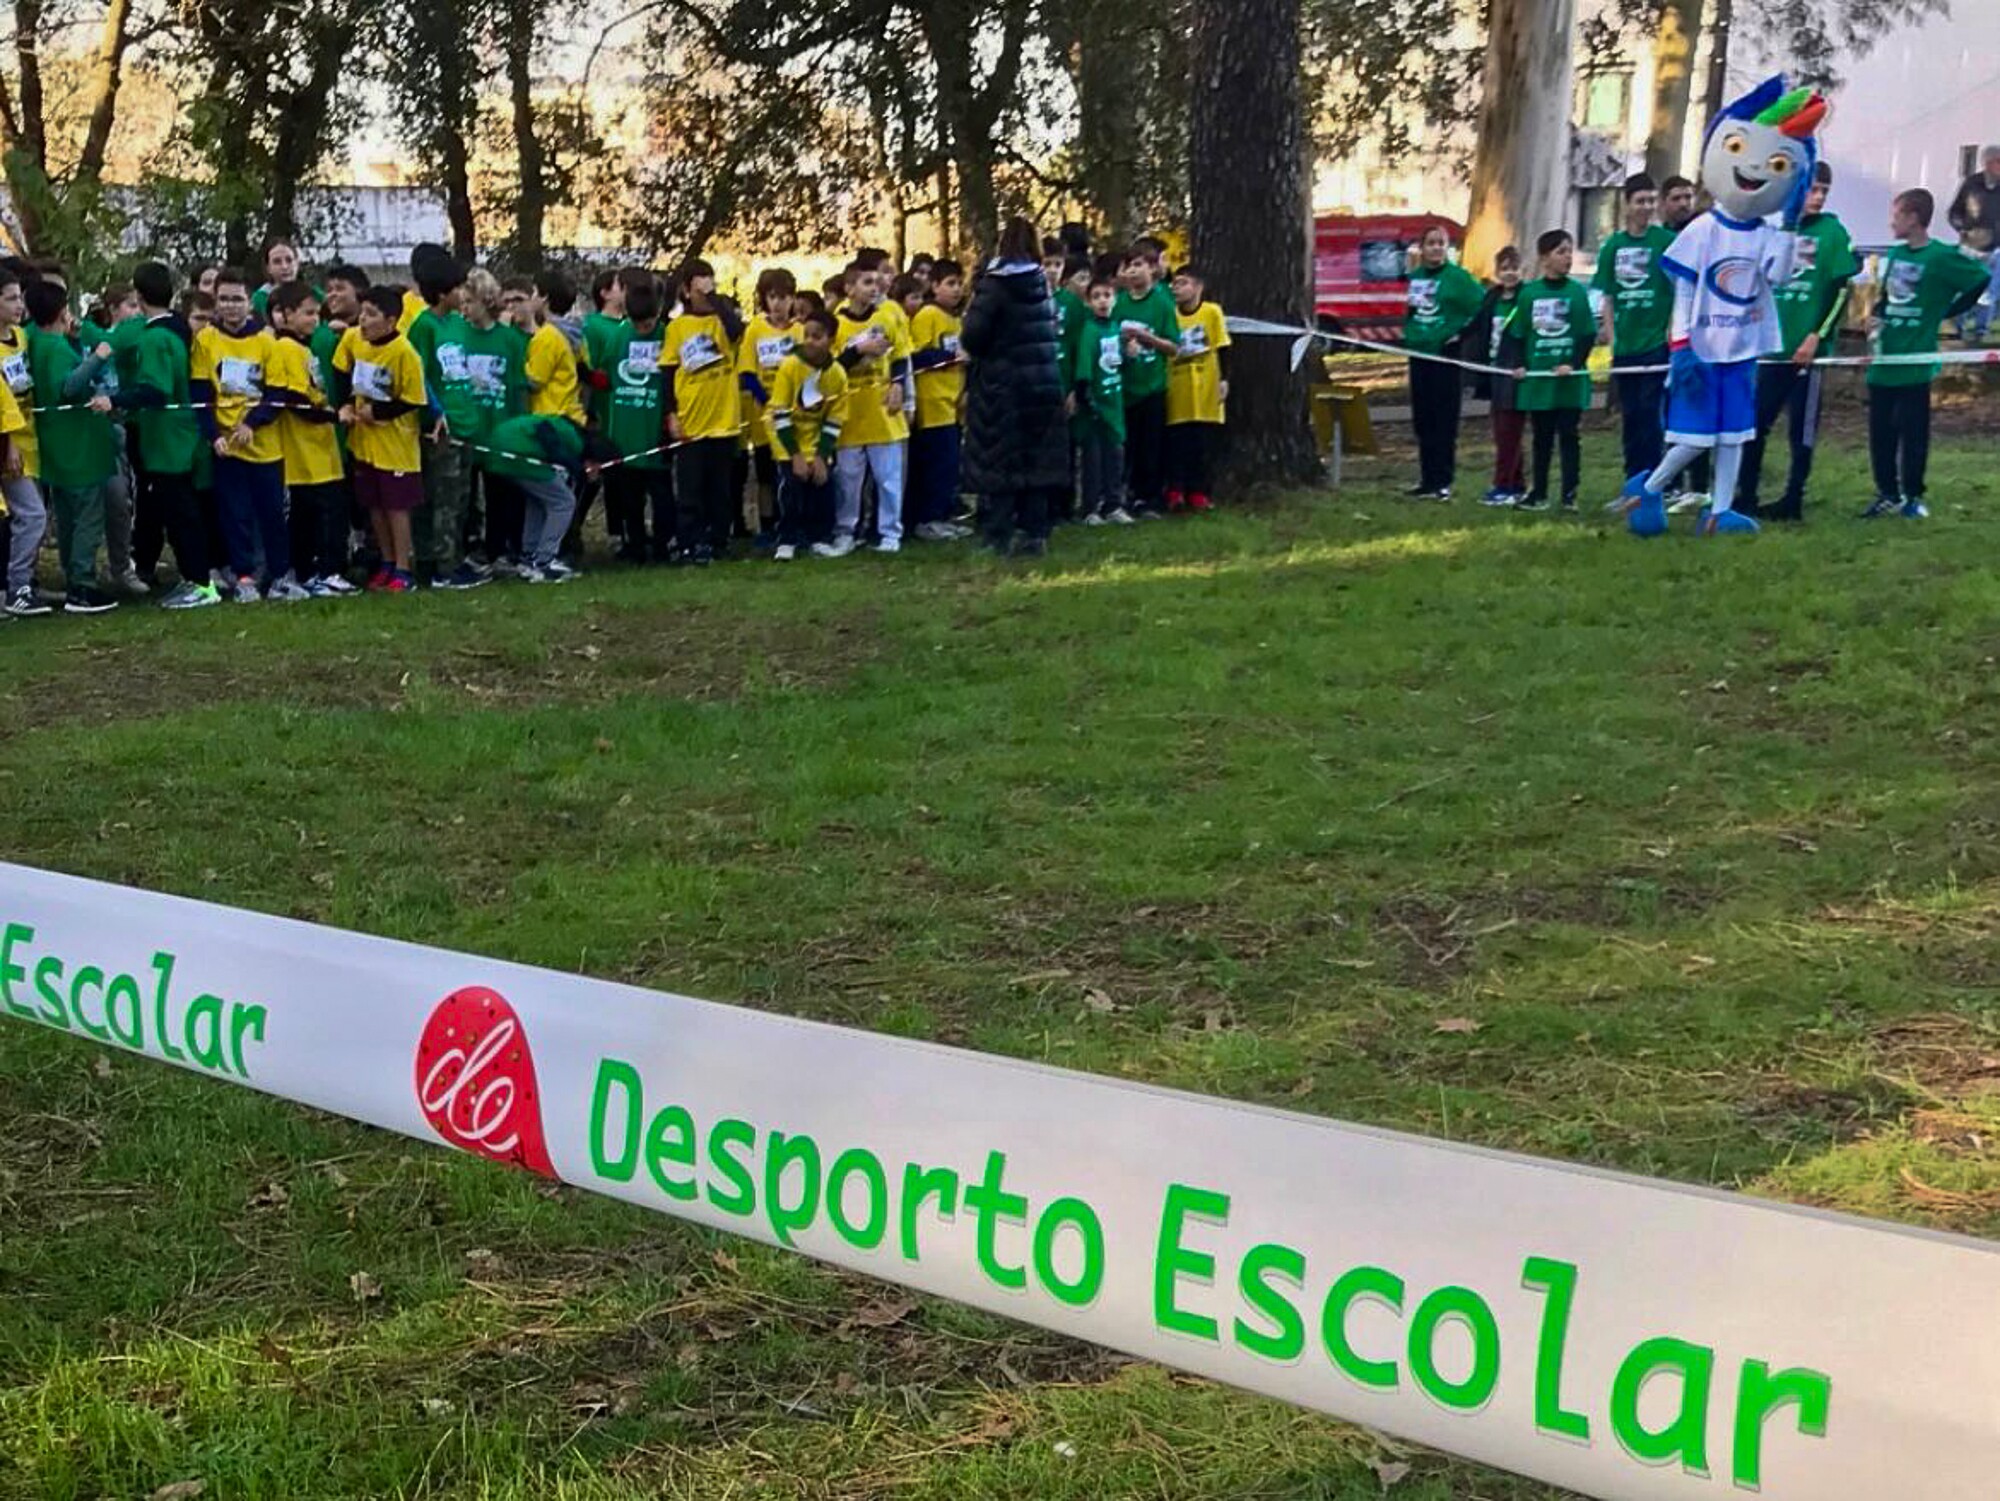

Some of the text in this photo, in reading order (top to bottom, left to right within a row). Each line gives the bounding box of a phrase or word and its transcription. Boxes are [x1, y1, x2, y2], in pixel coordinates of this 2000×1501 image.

[0, 922, 267, 1078] Escolar
[589, 1057, 1832, 1492] Desporto Escolar
